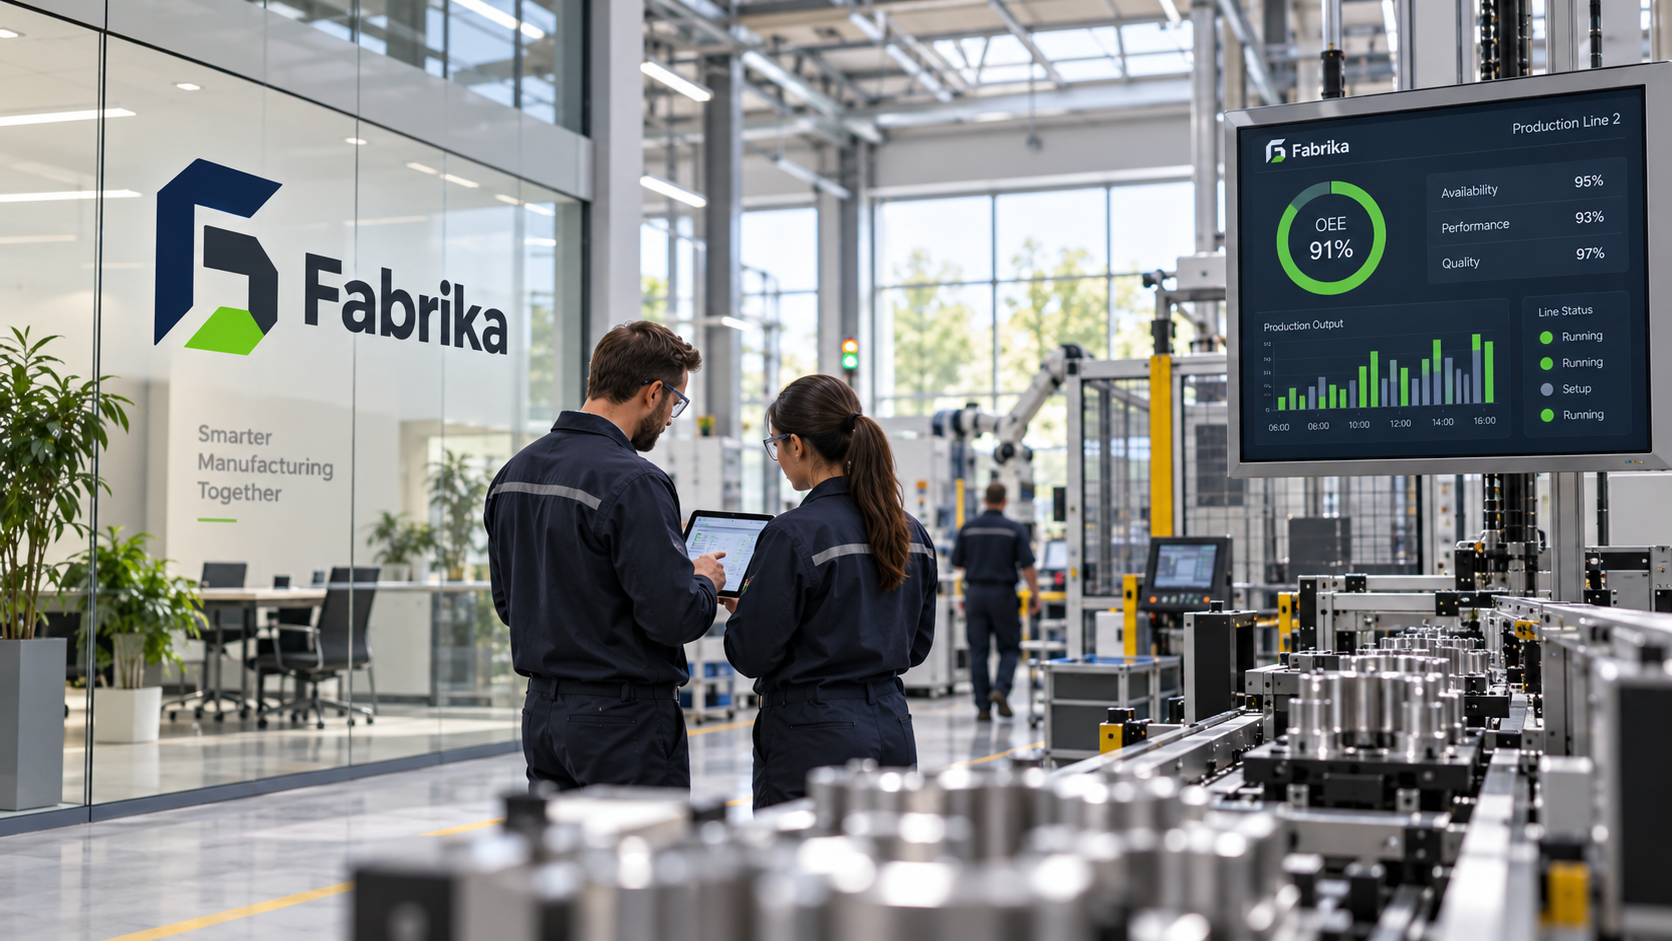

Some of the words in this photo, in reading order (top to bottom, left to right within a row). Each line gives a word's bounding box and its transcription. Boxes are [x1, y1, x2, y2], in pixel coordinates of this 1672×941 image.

[1513, 119, 1579, 134] Production
[1584, 116, 1608, 127] Line
[1613, 113, 1620, 124] 2
[1293, 140, 1349, 157] Fabrika
[1442, 184, 1498, 198] Availability
[1575, 175, 1603, 187] 95%
[1316, 216, 1346, 231] OEE
[1443, 221, 1509, 233] Performance
[1576, 211, 1604, 223] 93%
[1310, 239, 1353, 259] 91%
[1443, 257, 1480, 269] Quality
[1577, 247, 1605, 260] 97%
[305, 253, 507, 355] Fabrika
[1539, 308, 1559, 317] Line
[1562, 306, 1593, 315] Status
[1264, 322, 1310, 331] Production
[1313, 320, 1343, 330] Output
[1563, 331, 1602, 342] Running
[1563, 358, 1603, 368] Running
[1563, 384, 1591, 395] Setup
[1433, 418, 1454, 426] 14:00
[1564, 410, 1604, 421] Running
[199, 425, 272, 445] Smarter
[199, 453, 333, 481] Manufacturing
[198, 482, 282, 505] Together
